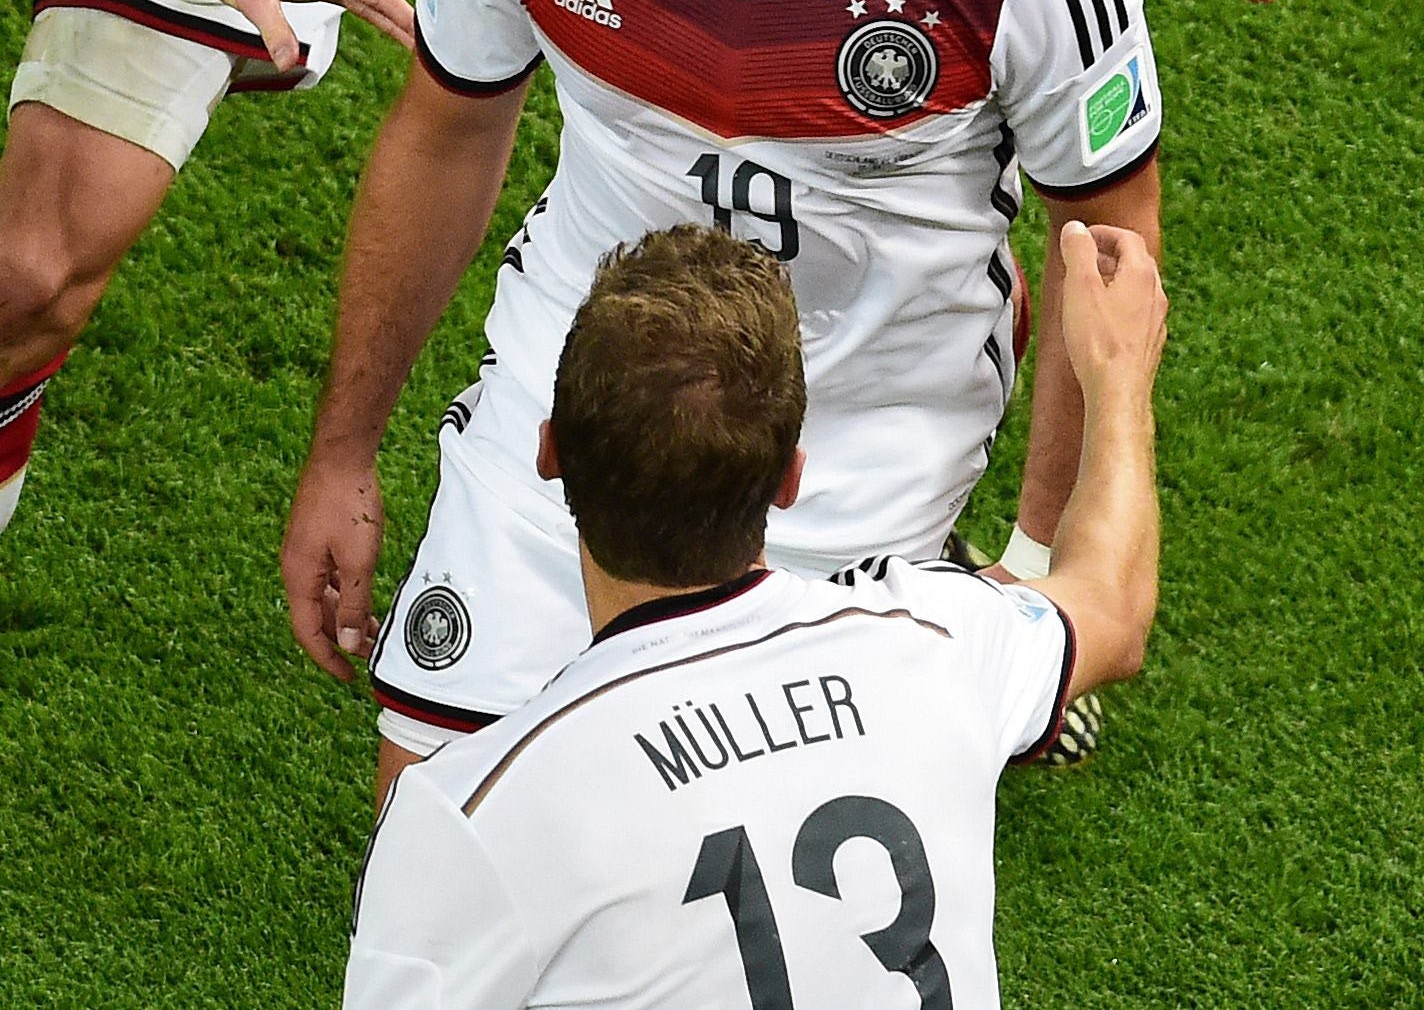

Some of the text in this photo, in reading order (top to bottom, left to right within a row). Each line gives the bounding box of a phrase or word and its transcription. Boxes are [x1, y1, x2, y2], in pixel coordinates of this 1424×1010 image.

[863, 34, 918, 54] DEUTSCHER
[686, 153, 800, 262] 19
[633, 674, 866, 791] MÜLLER
[682, 795, 954, 1010] 13
